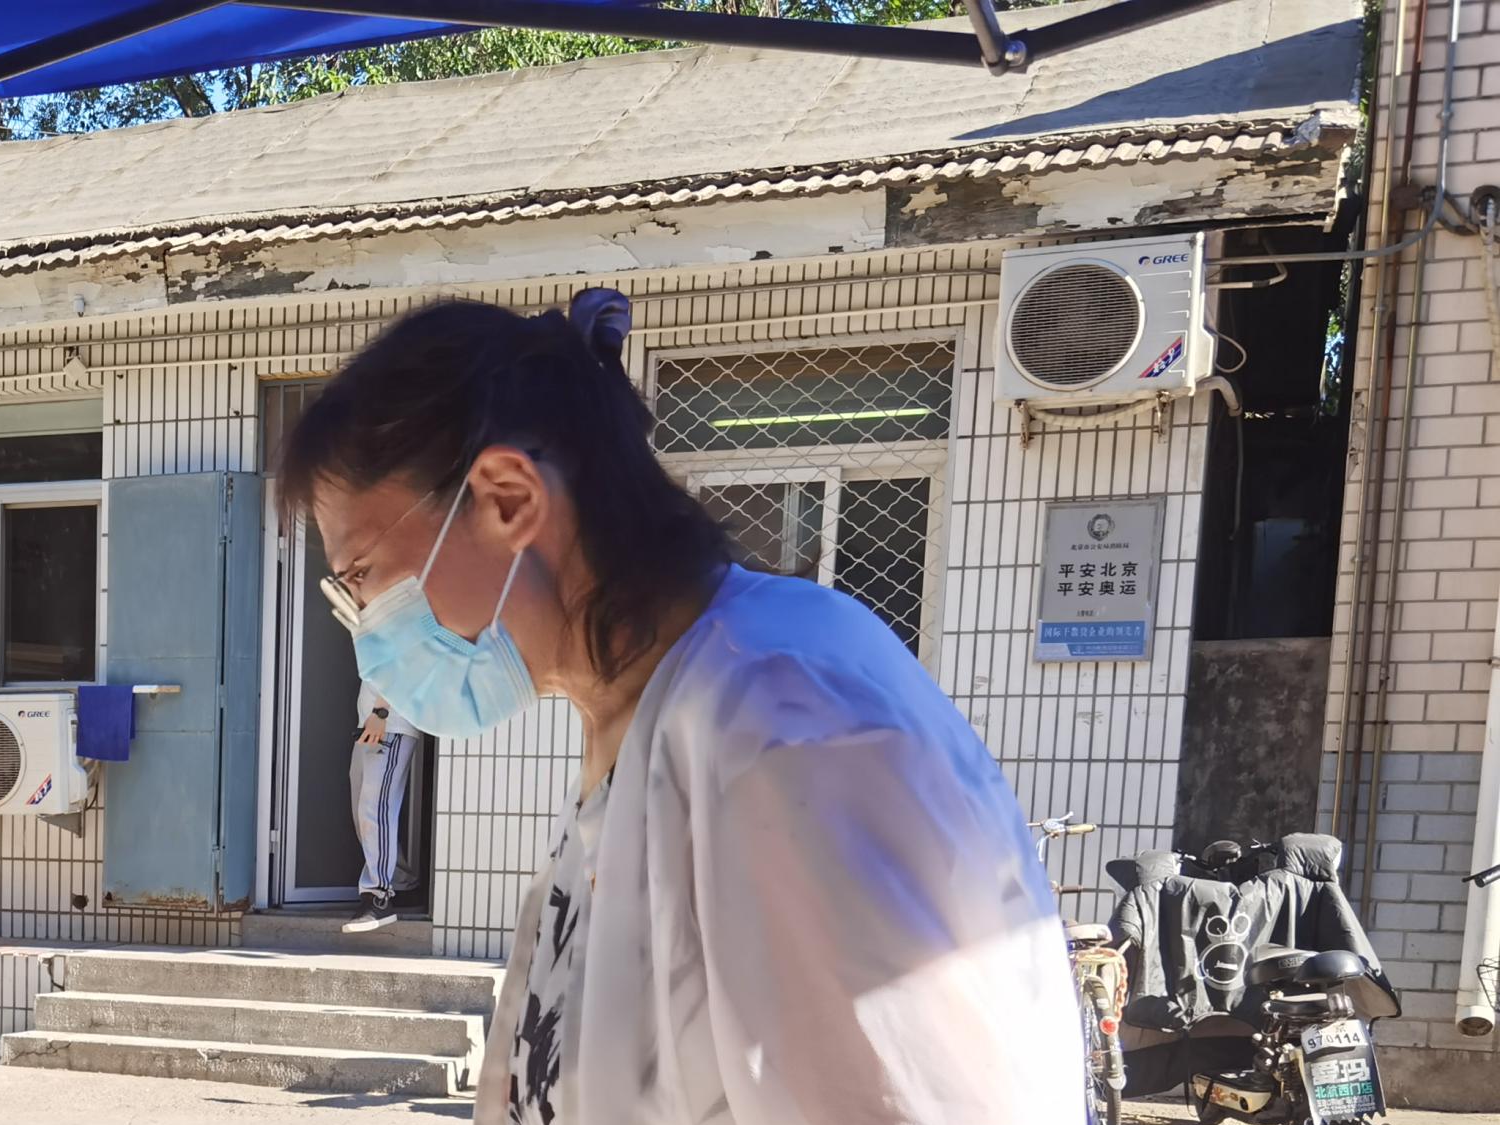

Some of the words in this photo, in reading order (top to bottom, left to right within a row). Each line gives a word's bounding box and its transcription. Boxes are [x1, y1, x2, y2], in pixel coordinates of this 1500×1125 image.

[1153, 253, 1189, 265] GREE
[1058, 561, 1138, 578] 平安北京
[1057, 580, 1136, 597] 平安奥运
[27, 710, 51, 718] GREE
[1307, 1032, 1361, 1049] 970114
[1314, 1081, 1374, 1099] 北航西门店
